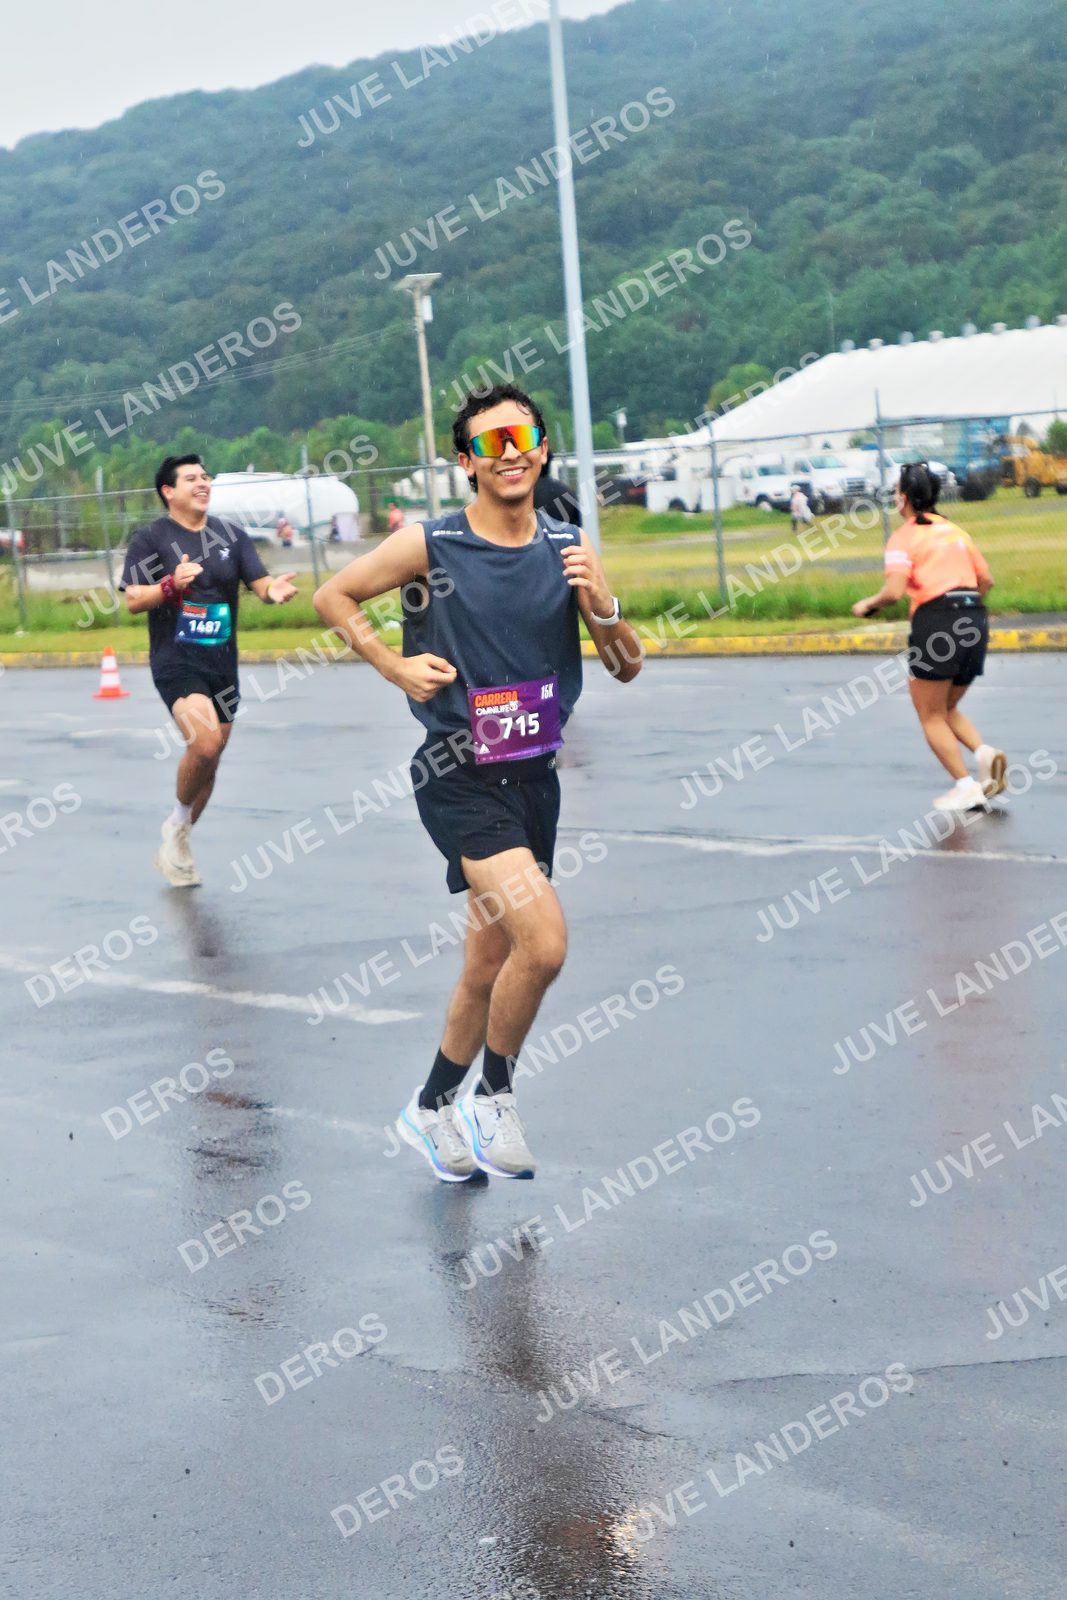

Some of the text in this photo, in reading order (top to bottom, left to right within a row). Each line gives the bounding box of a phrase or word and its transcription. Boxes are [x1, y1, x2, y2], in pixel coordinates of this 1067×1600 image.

[189, 619, 221, 635] 1487
[475, 690, 518, 708] CARRERA
[541, 683, 554, 699] 15K
[499, 712, 540, 739] 715
